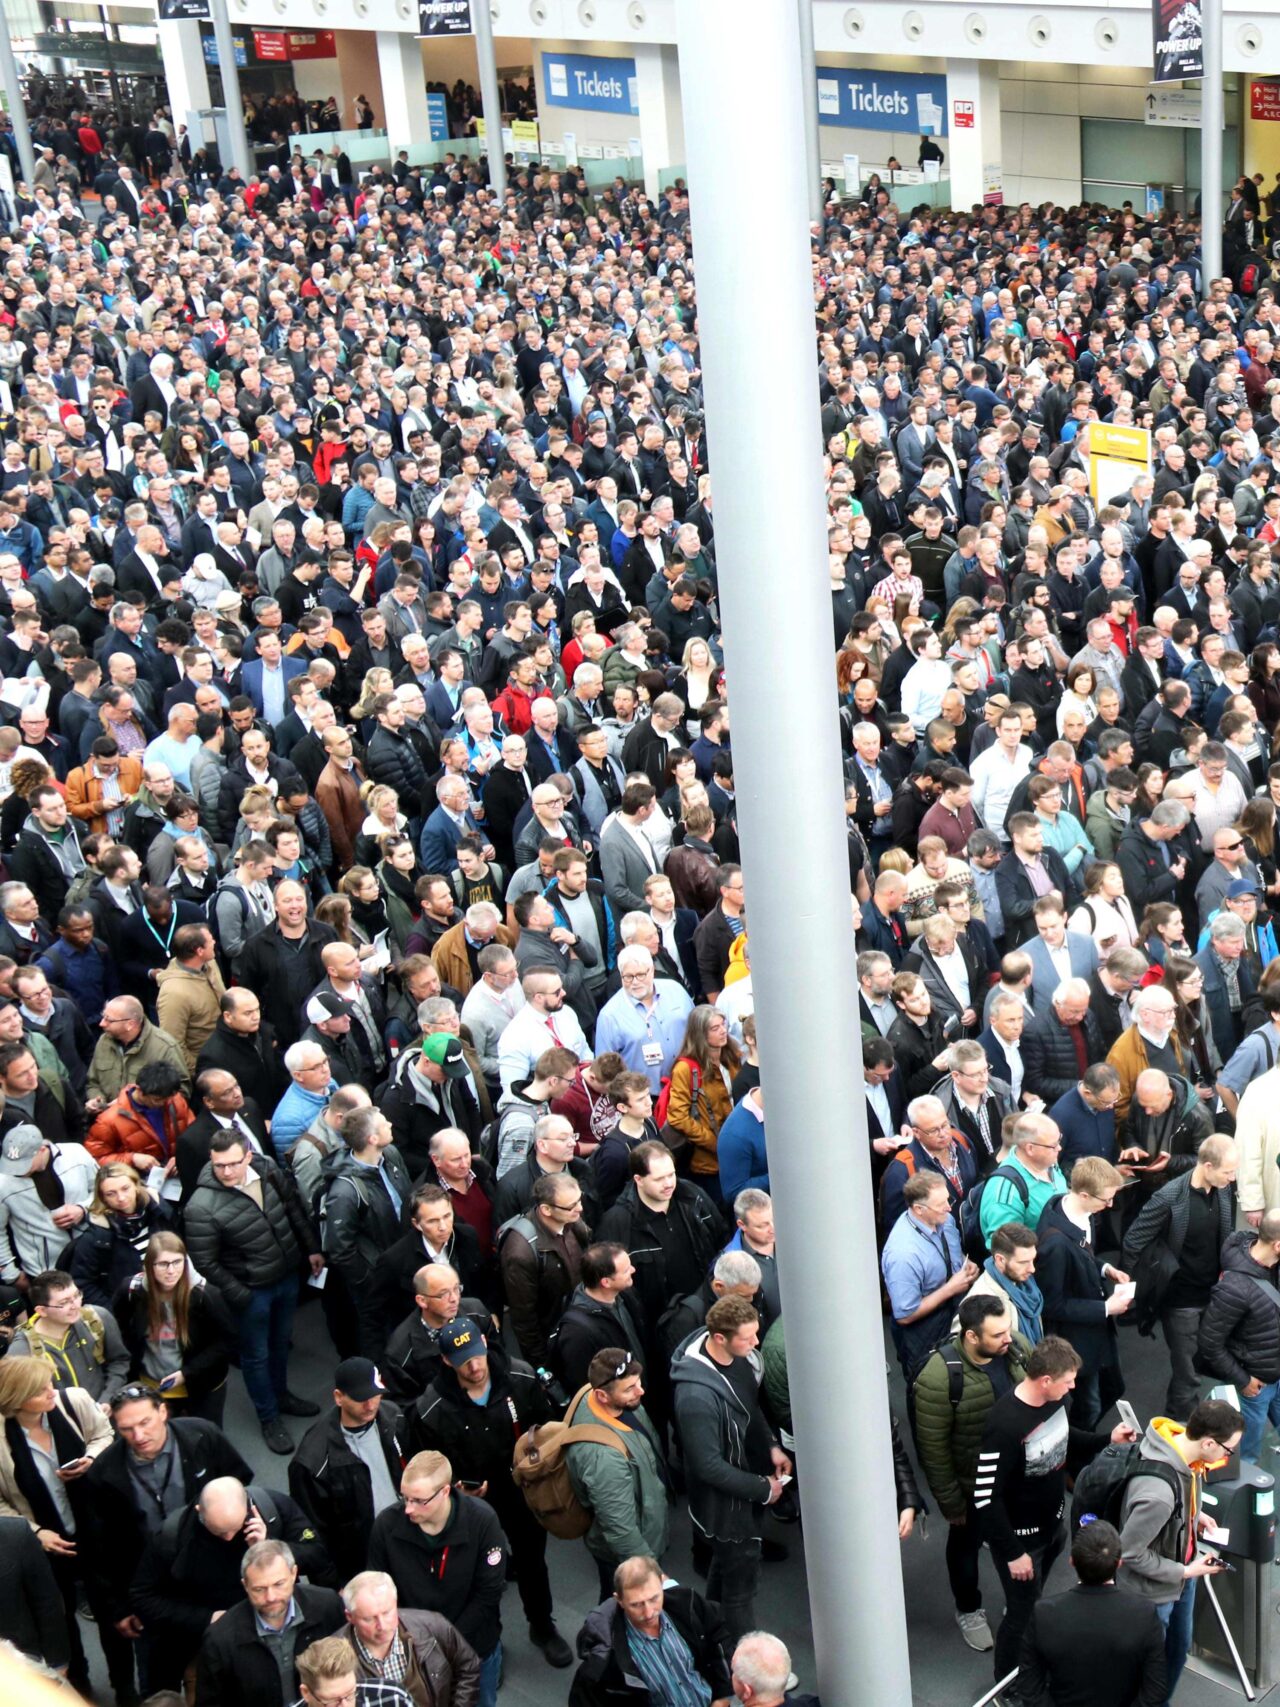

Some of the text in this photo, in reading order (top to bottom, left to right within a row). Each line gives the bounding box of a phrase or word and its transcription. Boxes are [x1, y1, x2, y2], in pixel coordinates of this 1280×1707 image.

[420, 2, 468, 14] POWER UP
[1156, 38, 1202, 54] POWER UP
[574, 70, 622, 98] Tickets
[848, 82, 909, 115] Tickets
[453, 1332, 470, 1347] CAT
